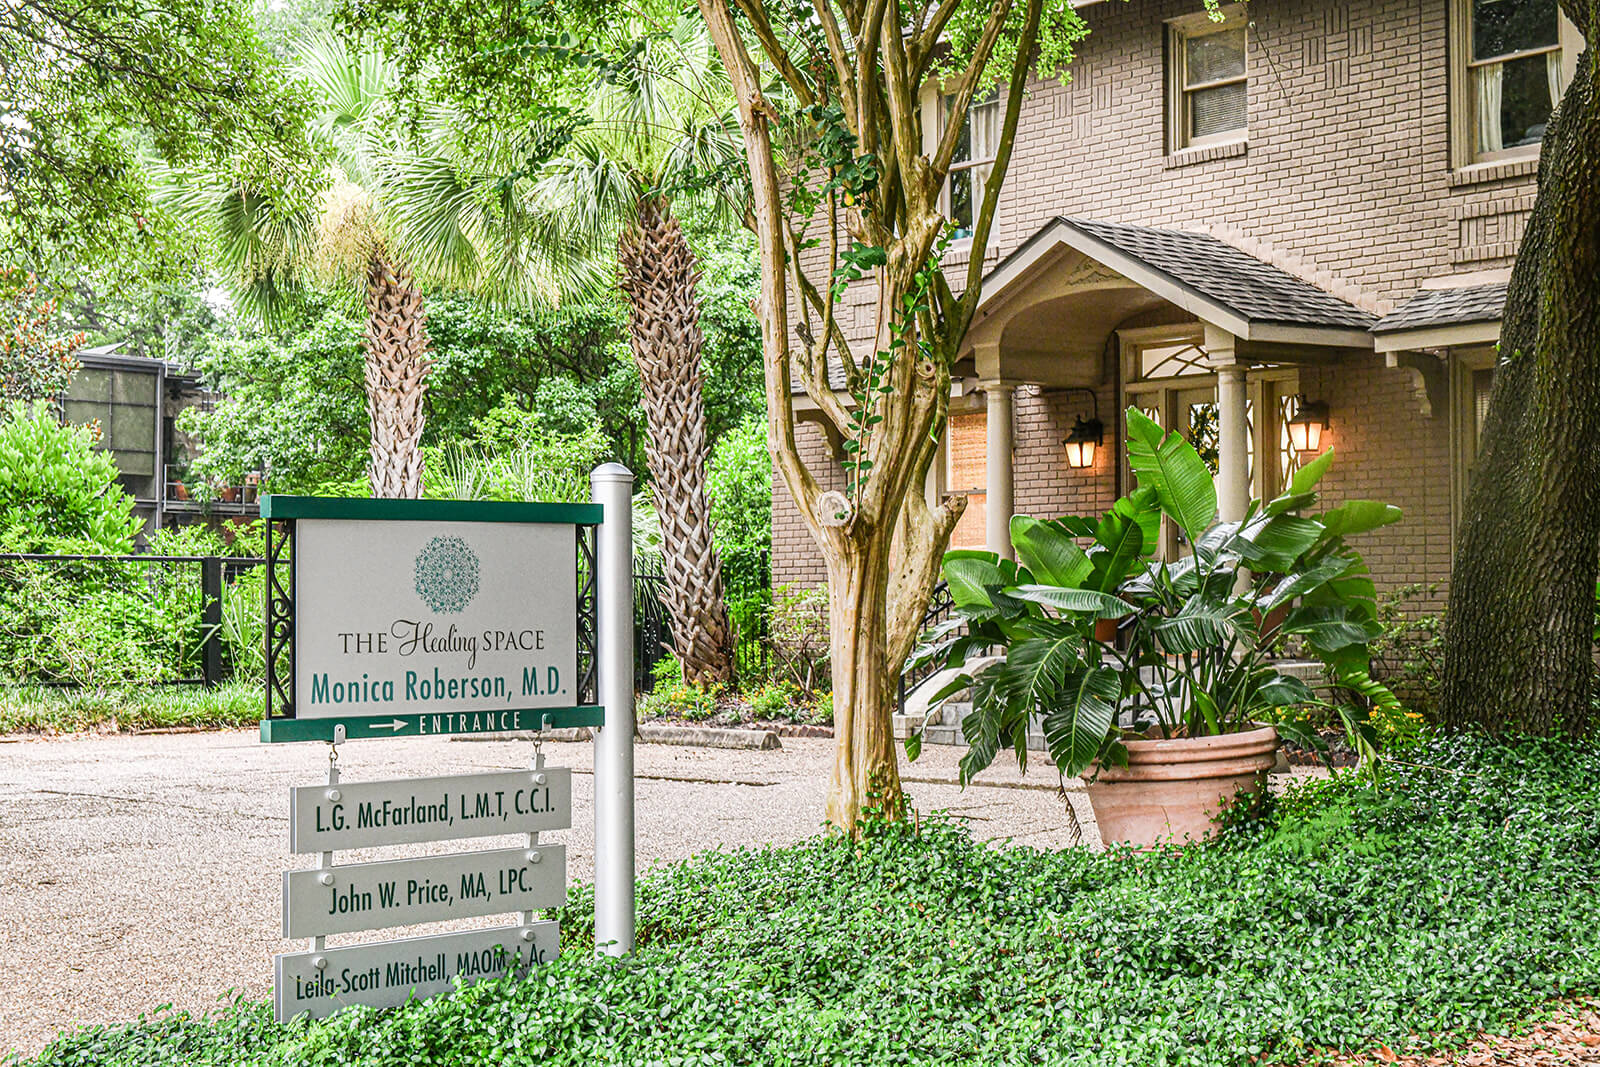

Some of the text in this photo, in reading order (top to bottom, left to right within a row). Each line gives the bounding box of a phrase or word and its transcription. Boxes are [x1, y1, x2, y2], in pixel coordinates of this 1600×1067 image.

[338, 619, 545, 670] THE Healing SPACE
[311, 665, 567, 705] Monica Roberson, M.D.
[419, 711, 521, 735] ENTRANCE
[316, 804, 350, 833] L.G.
[357, 793, 454, 829] McFarland,
[460, 791, 509, 822] L.M.T,
[328, 867, 533, 915] John W. Price, MA, LPC.
[296, 966, 380, 1000] Leila-Scott
[385, 953, 451, 988] Mitchell,
